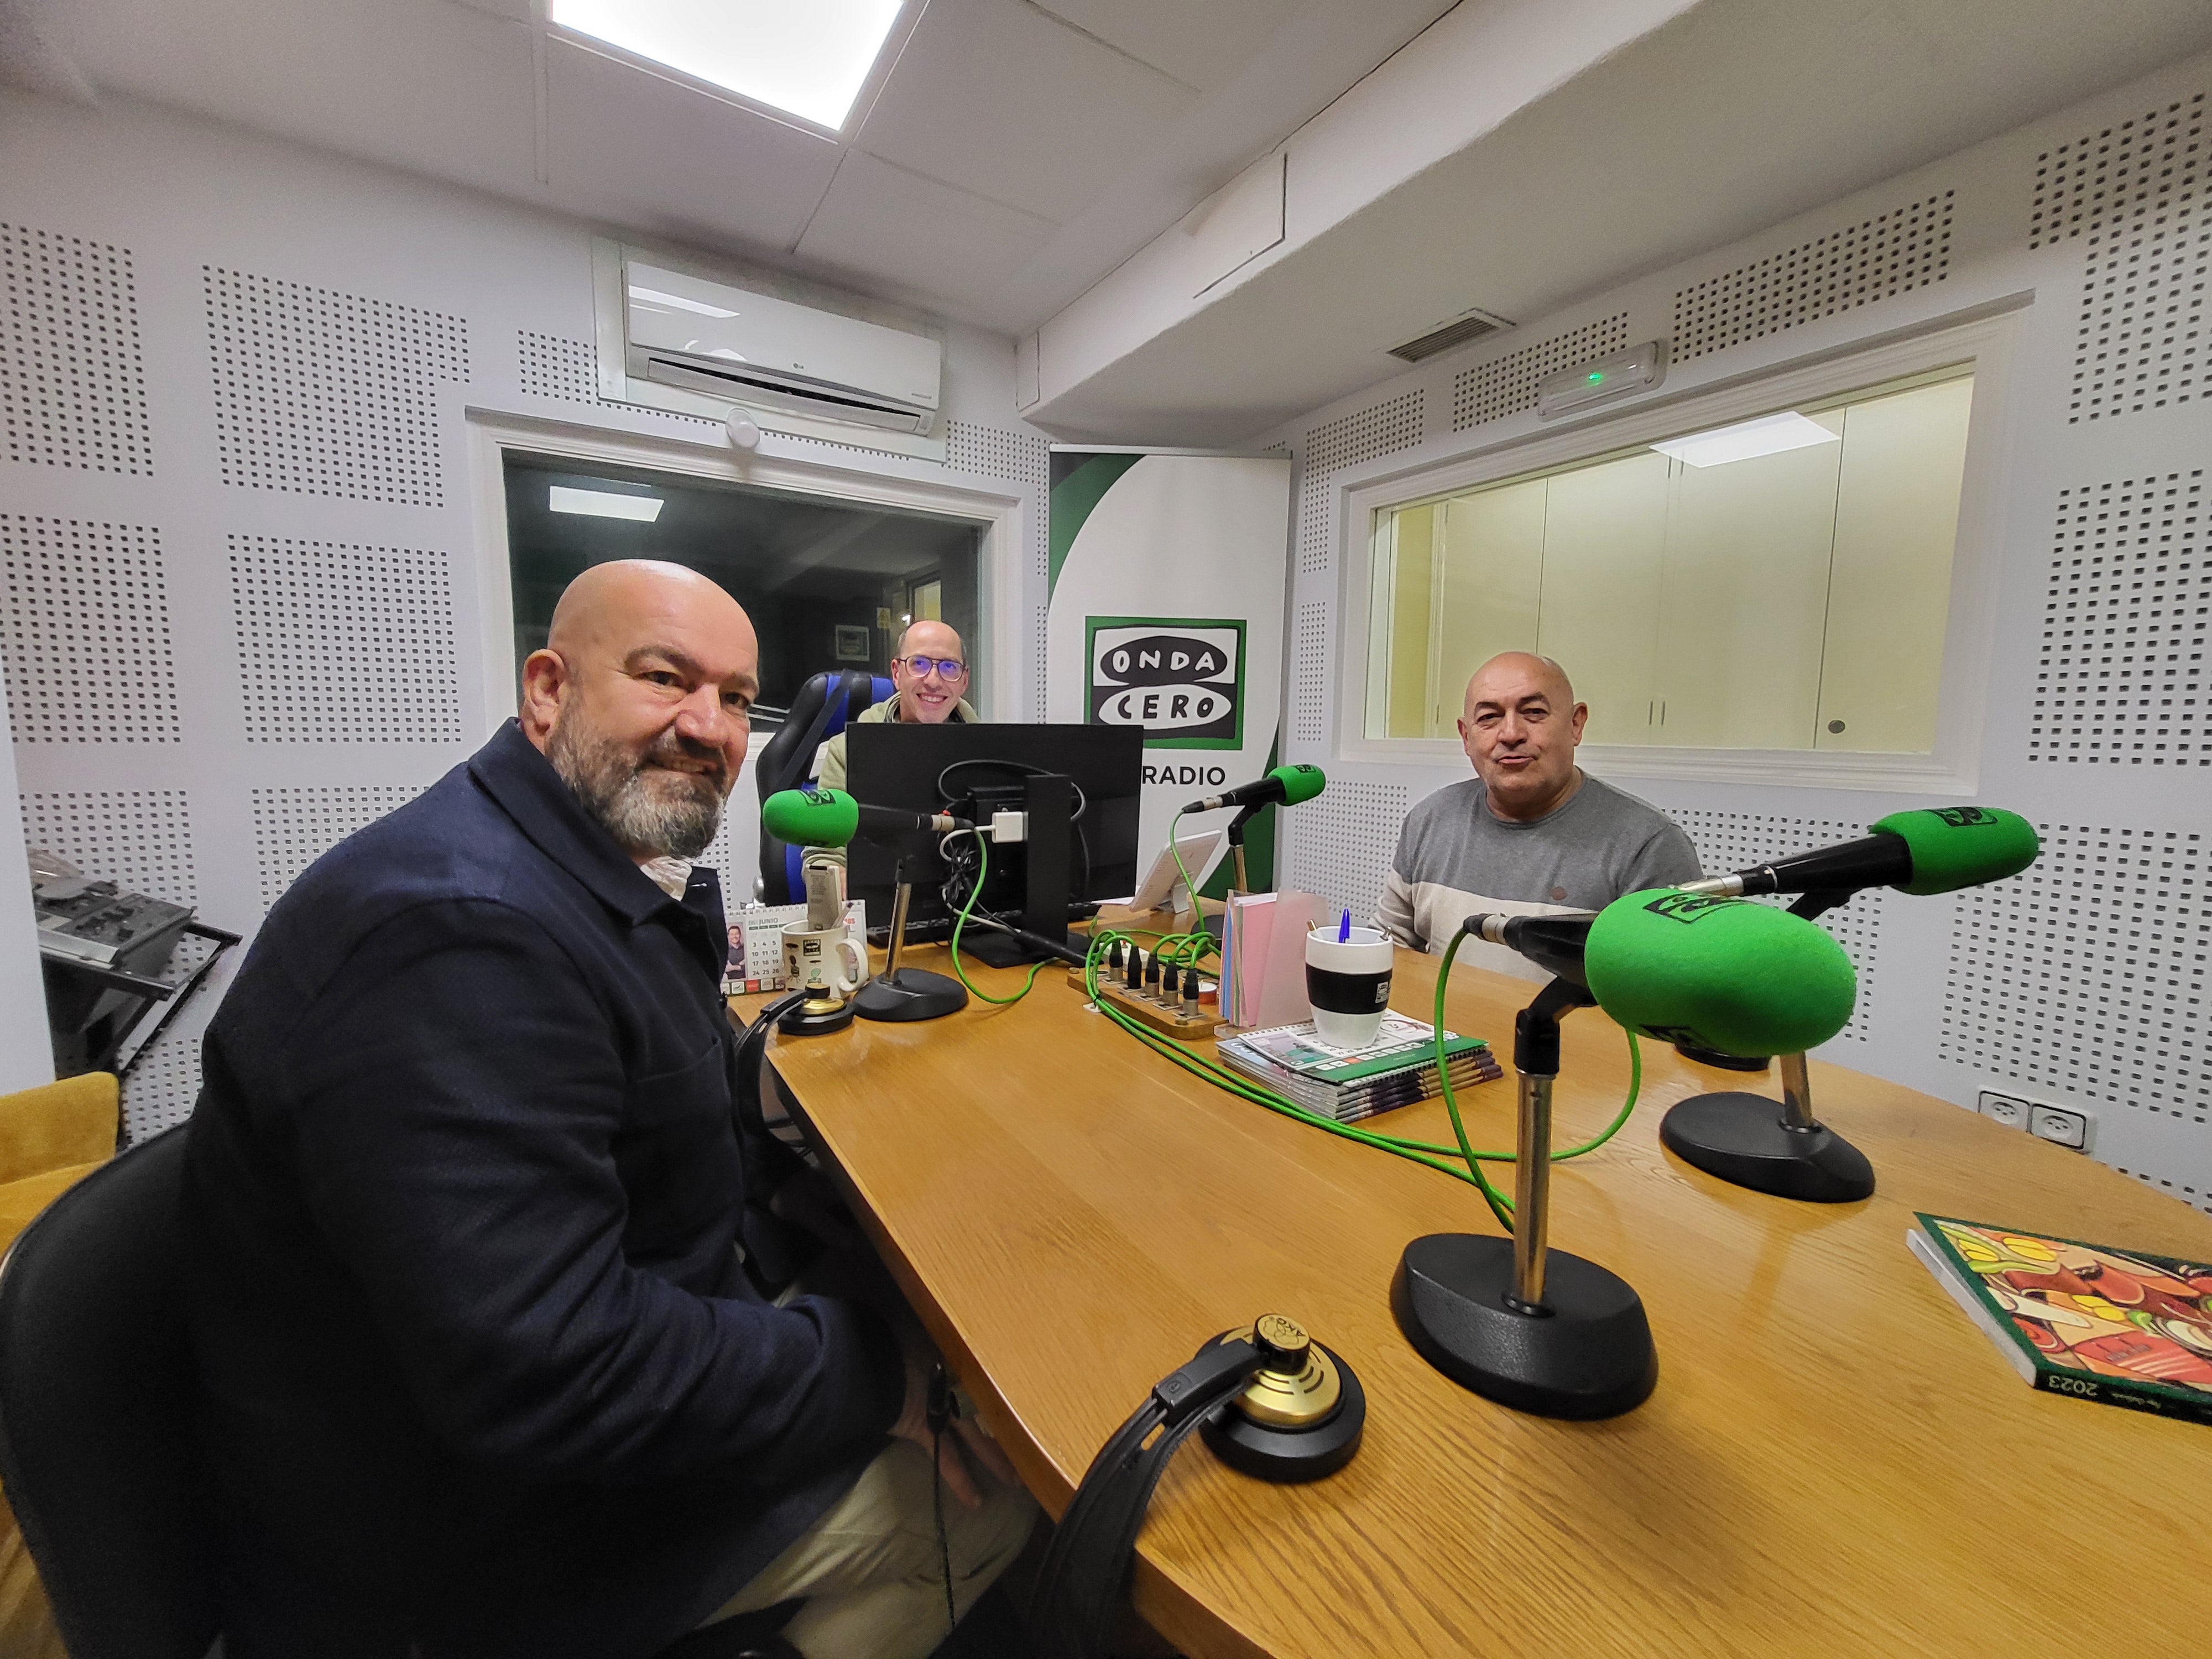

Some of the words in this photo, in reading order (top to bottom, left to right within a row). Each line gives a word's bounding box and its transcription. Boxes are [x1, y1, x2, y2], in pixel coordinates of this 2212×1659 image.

[1112, 649, 1215, 673] ONDA
[1117, 694, 1214, 719] CERO
[1142, 766, 1226, 786] RADIO
[1276, 1317, 1306, 1337] AKG
[2049, 1375, 2099, 1396] 2023
